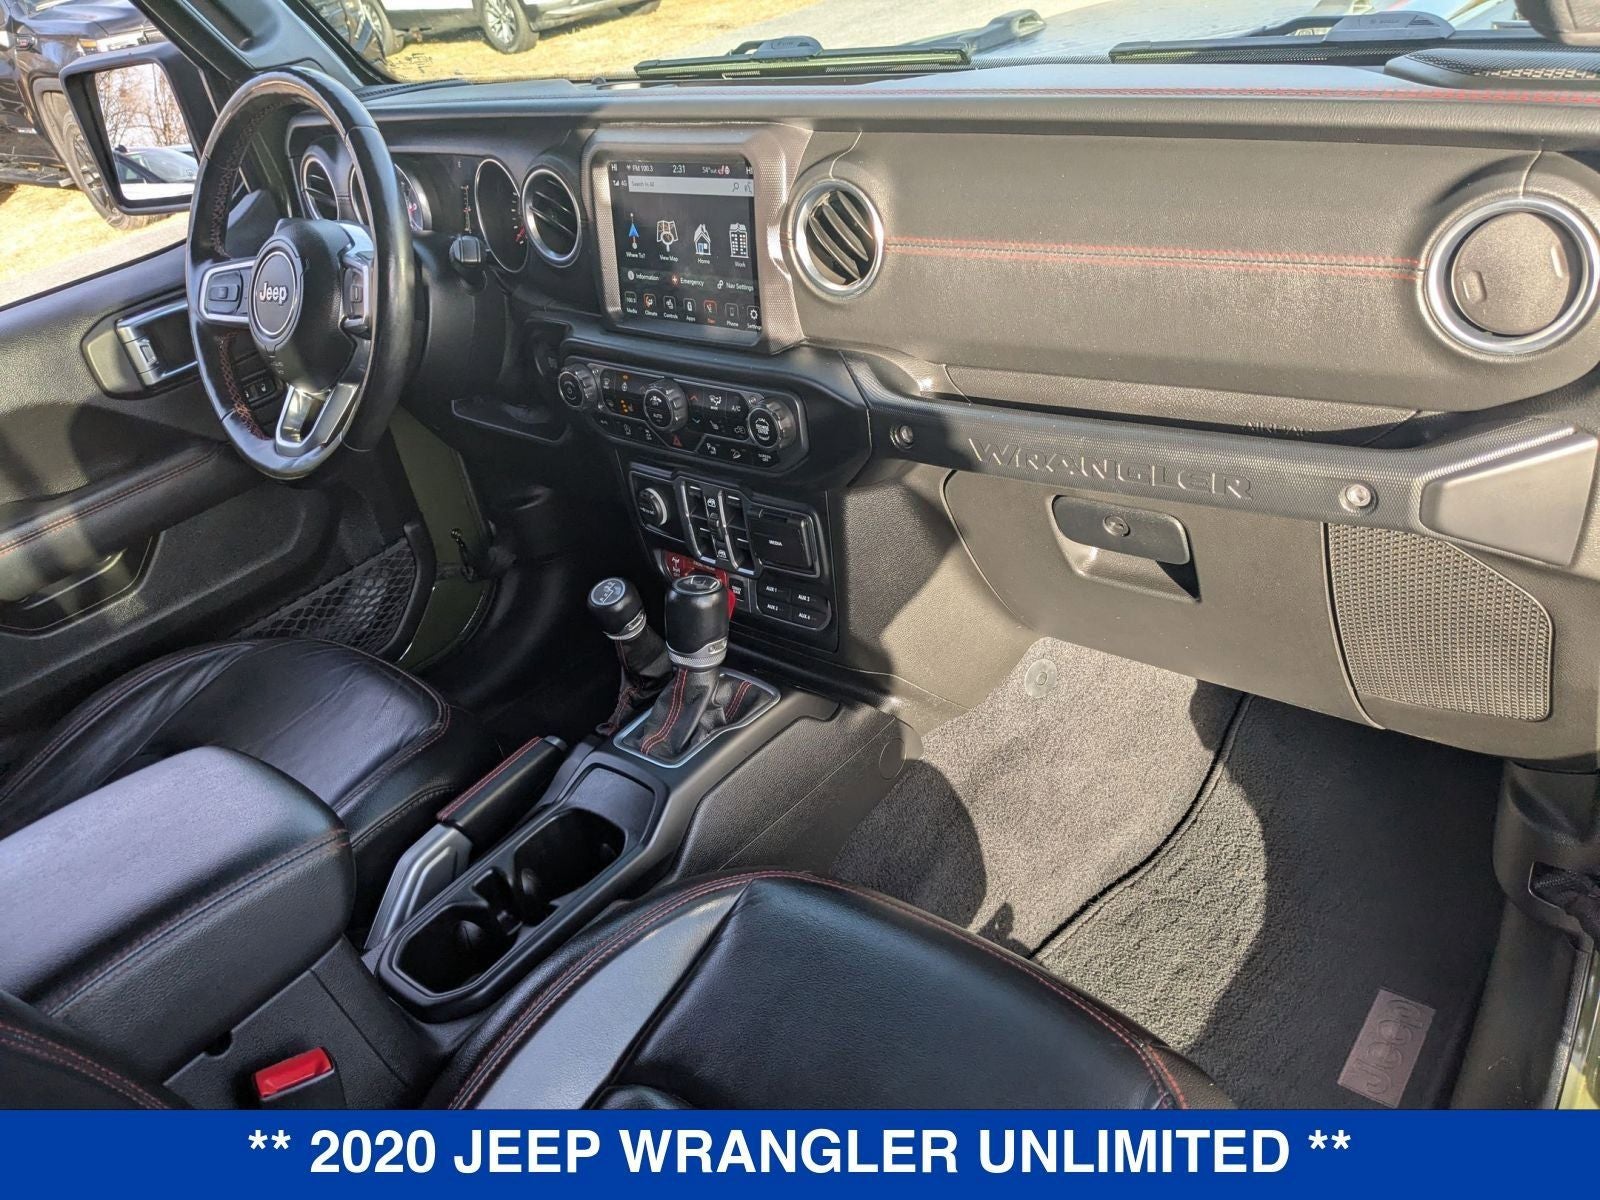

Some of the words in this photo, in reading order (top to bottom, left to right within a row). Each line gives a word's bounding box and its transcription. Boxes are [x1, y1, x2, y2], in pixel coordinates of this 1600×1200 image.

[672, 164, 686, 174] 2:31
[635, 273, 660, 281] Information
[680, 278, 705, 287] Emergency
[735, 283, 755, 292] Settings
[259, 282, 288, 306] Jeep
[731, 404, 741, 412] A/C
[967, 437, 1252, 499] WRANGLER
